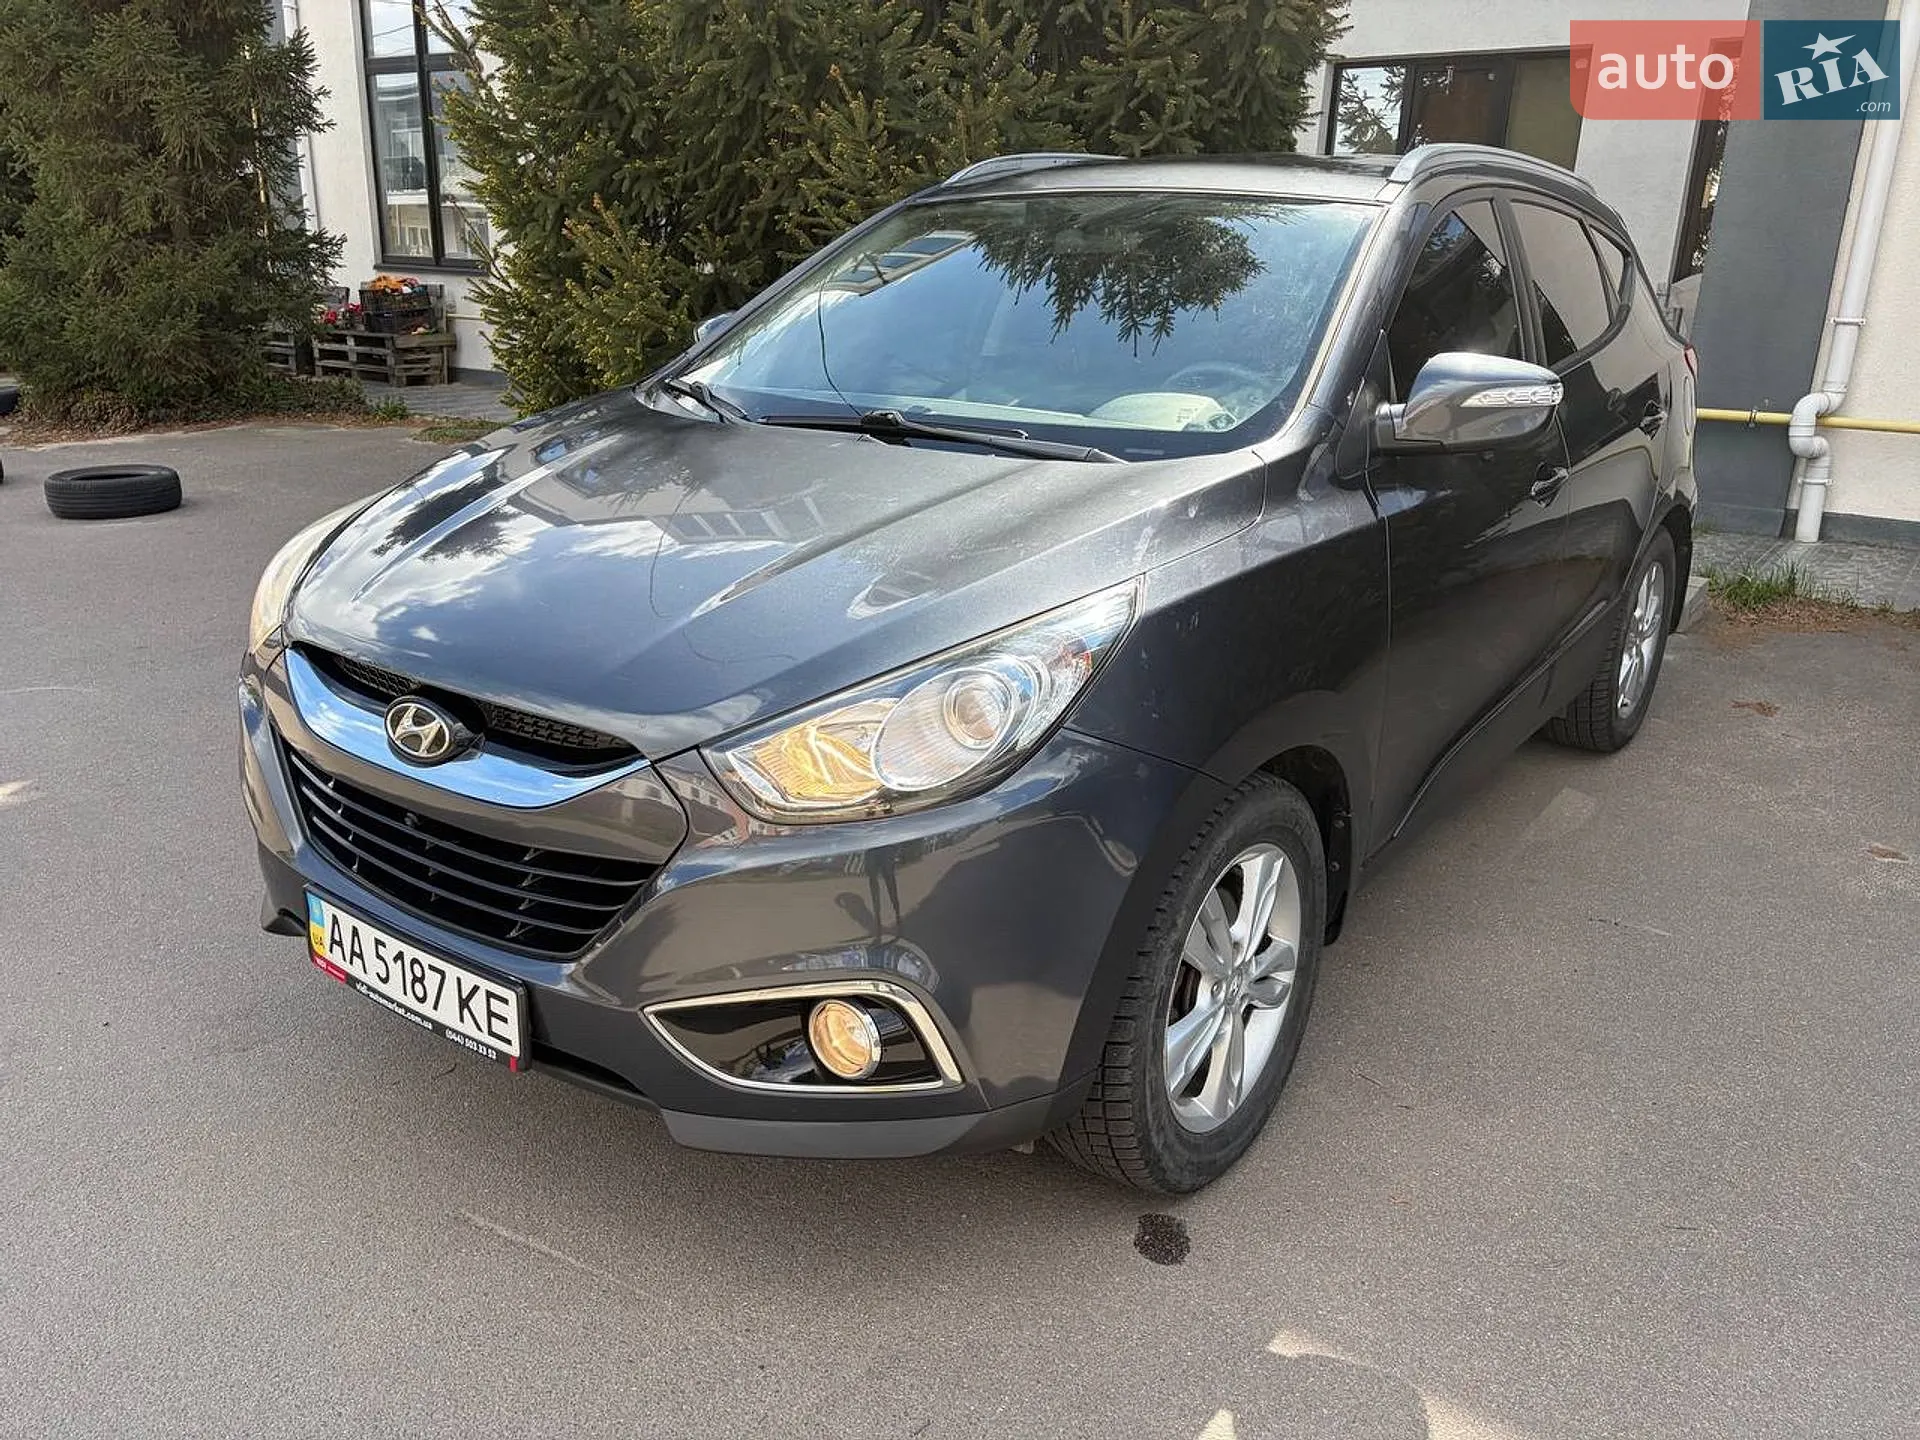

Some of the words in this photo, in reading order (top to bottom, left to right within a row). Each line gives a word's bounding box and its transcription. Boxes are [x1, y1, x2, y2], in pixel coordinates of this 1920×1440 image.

[312, 931, 326, 950] UA
[329, 913, 368, 975] AA
[374, 938, 447, 1012] 5187
[456, 976, 513, 1047] KE
